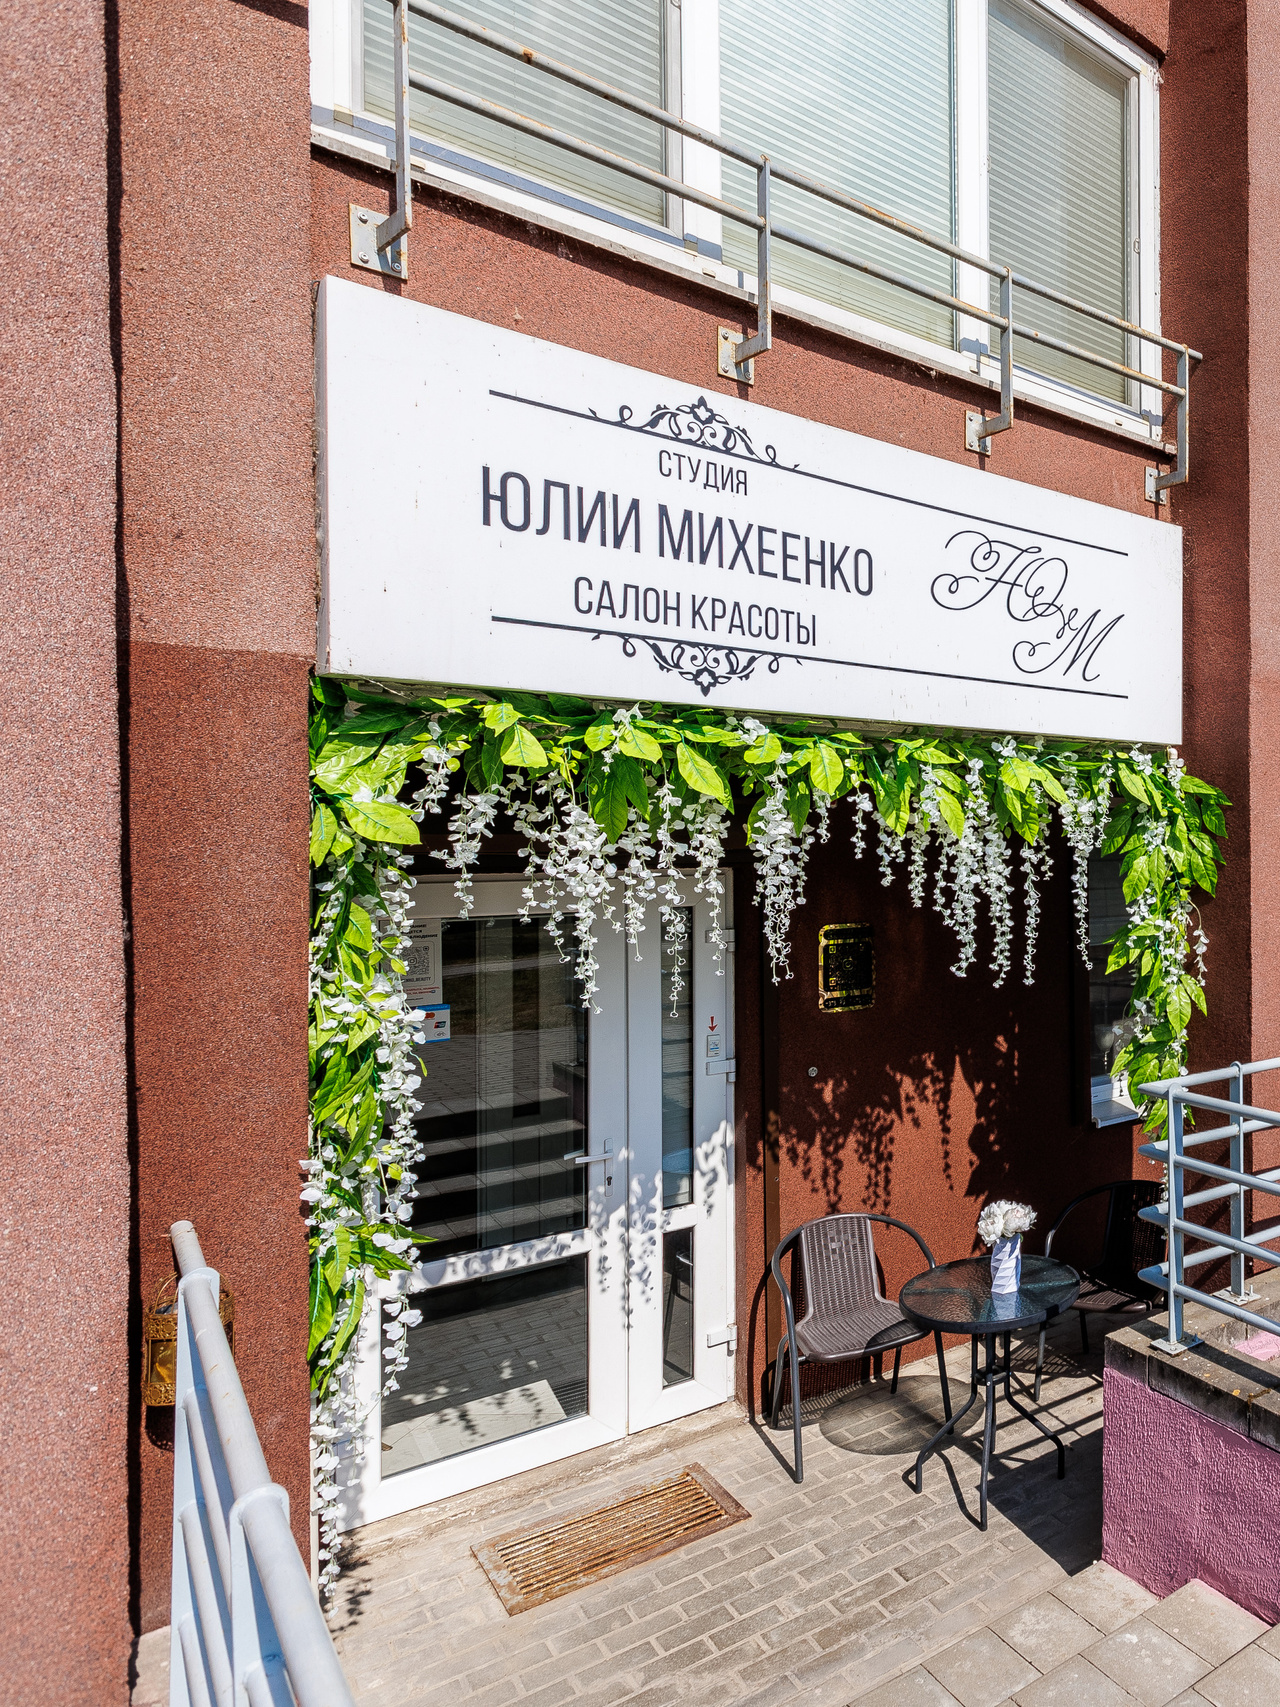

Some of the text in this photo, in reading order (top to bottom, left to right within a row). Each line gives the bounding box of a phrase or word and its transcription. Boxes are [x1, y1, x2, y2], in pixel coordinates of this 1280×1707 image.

[658, 449, 748, 496] СТУДИЯ
[482, 465, 873, 597] ЮЛИИ МИХЕЕНКО
[574, 576, 816, 648] САЛОН КРАСОТЫ
